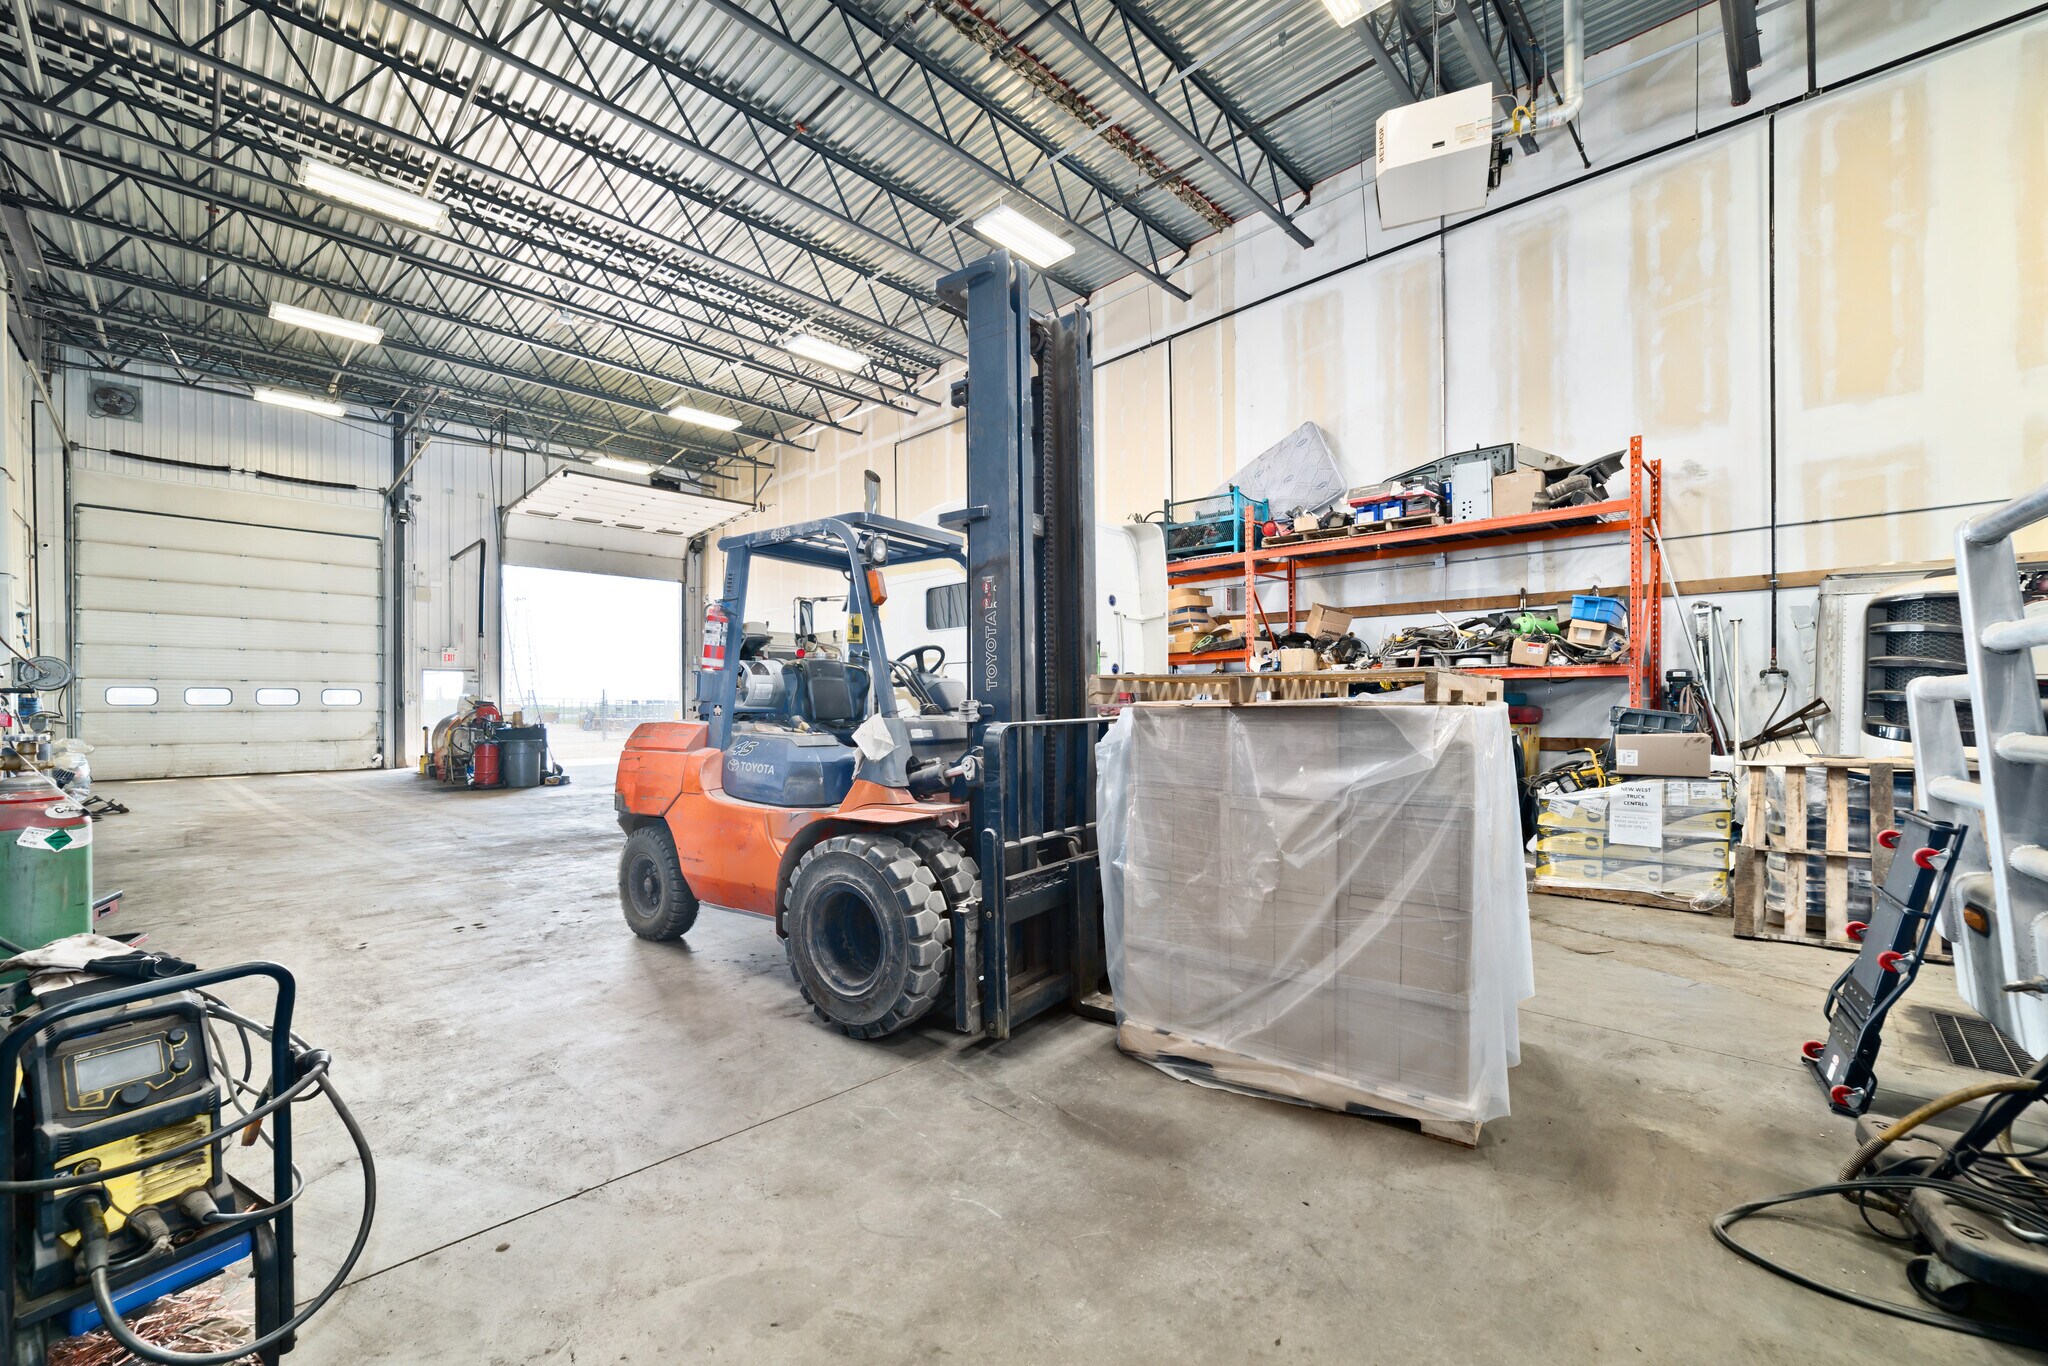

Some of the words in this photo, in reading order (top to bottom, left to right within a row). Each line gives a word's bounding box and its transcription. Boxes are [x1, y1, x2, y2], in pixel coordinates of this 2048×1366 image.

[444, 654, 455, 662] EXIT
[985, 610, 998, 692] TOYOTA
[730, 740, 760, 757] 45
[740, 761, 775, 775] TOYOTA
